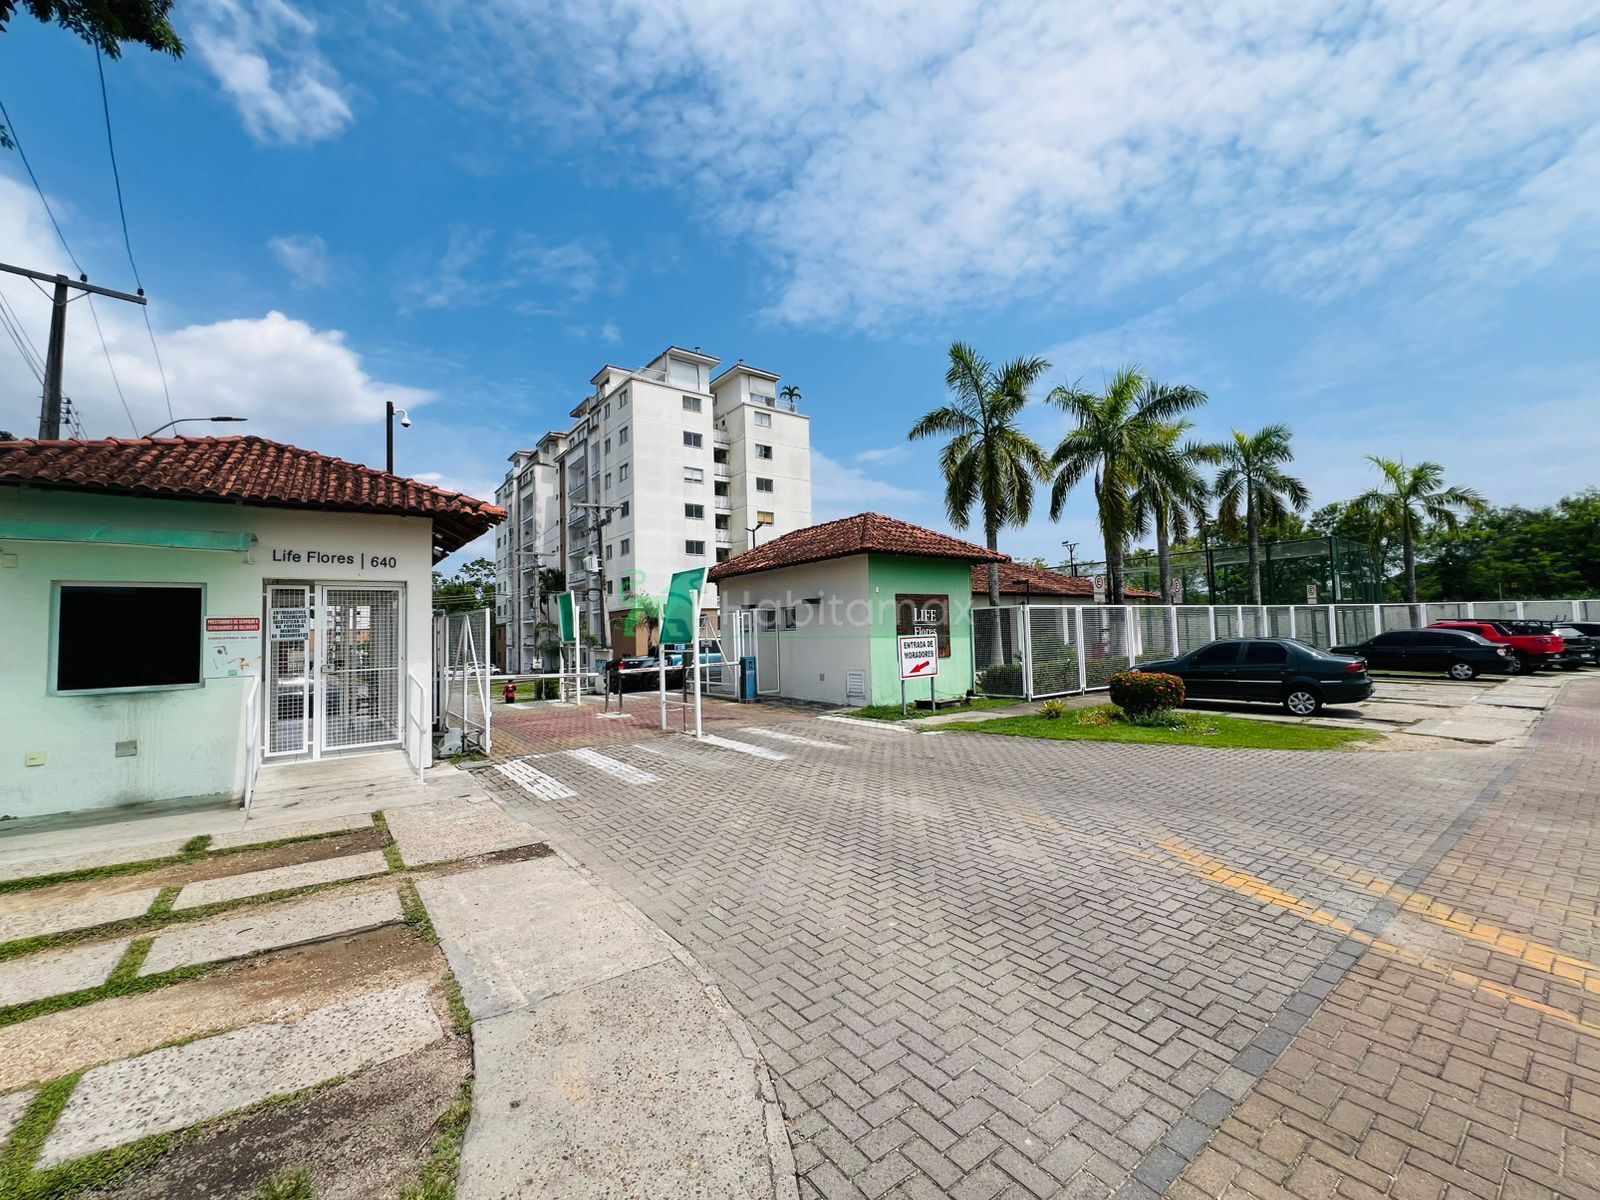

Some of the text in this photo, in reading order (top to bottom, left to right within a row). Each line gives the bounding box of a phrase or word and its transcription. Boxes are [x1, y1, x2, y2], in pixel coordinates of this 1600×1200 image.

[272, 549, 301, 562] Life
[307, 551, 354, 564] Flores
[370, 556, 397, 568] 640
[913, 607, 937, 622] LIFE
[904, 640, 933, 649] ENTRADA DE
[904, 650, 934, 659] MORADORES
